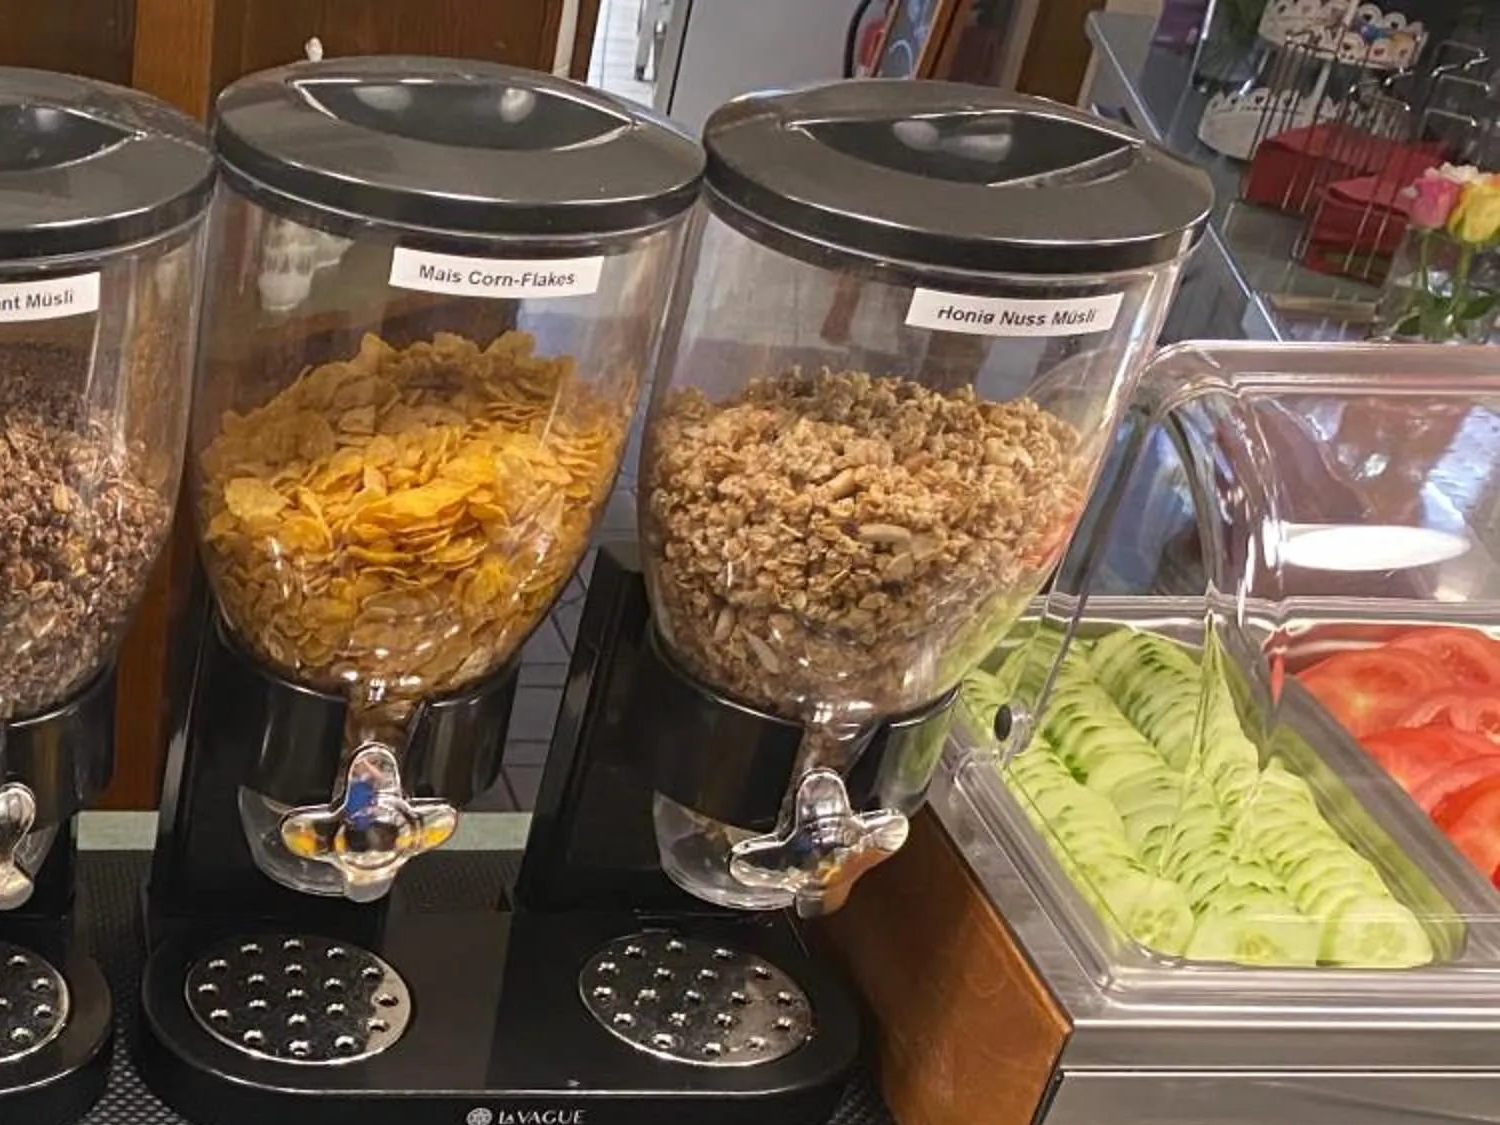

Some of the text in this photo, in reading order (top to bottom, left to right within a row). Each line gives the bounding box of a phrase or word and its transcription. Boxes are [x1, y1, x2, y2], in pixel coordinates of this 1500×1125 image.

[418, 264, 576, 288] Mais Corn-Flakes
[25, 289, 74, 309] Müsli
[999, 310, 1047, 326] Nuss
[1051, 308, 1098, 326] Müsli
